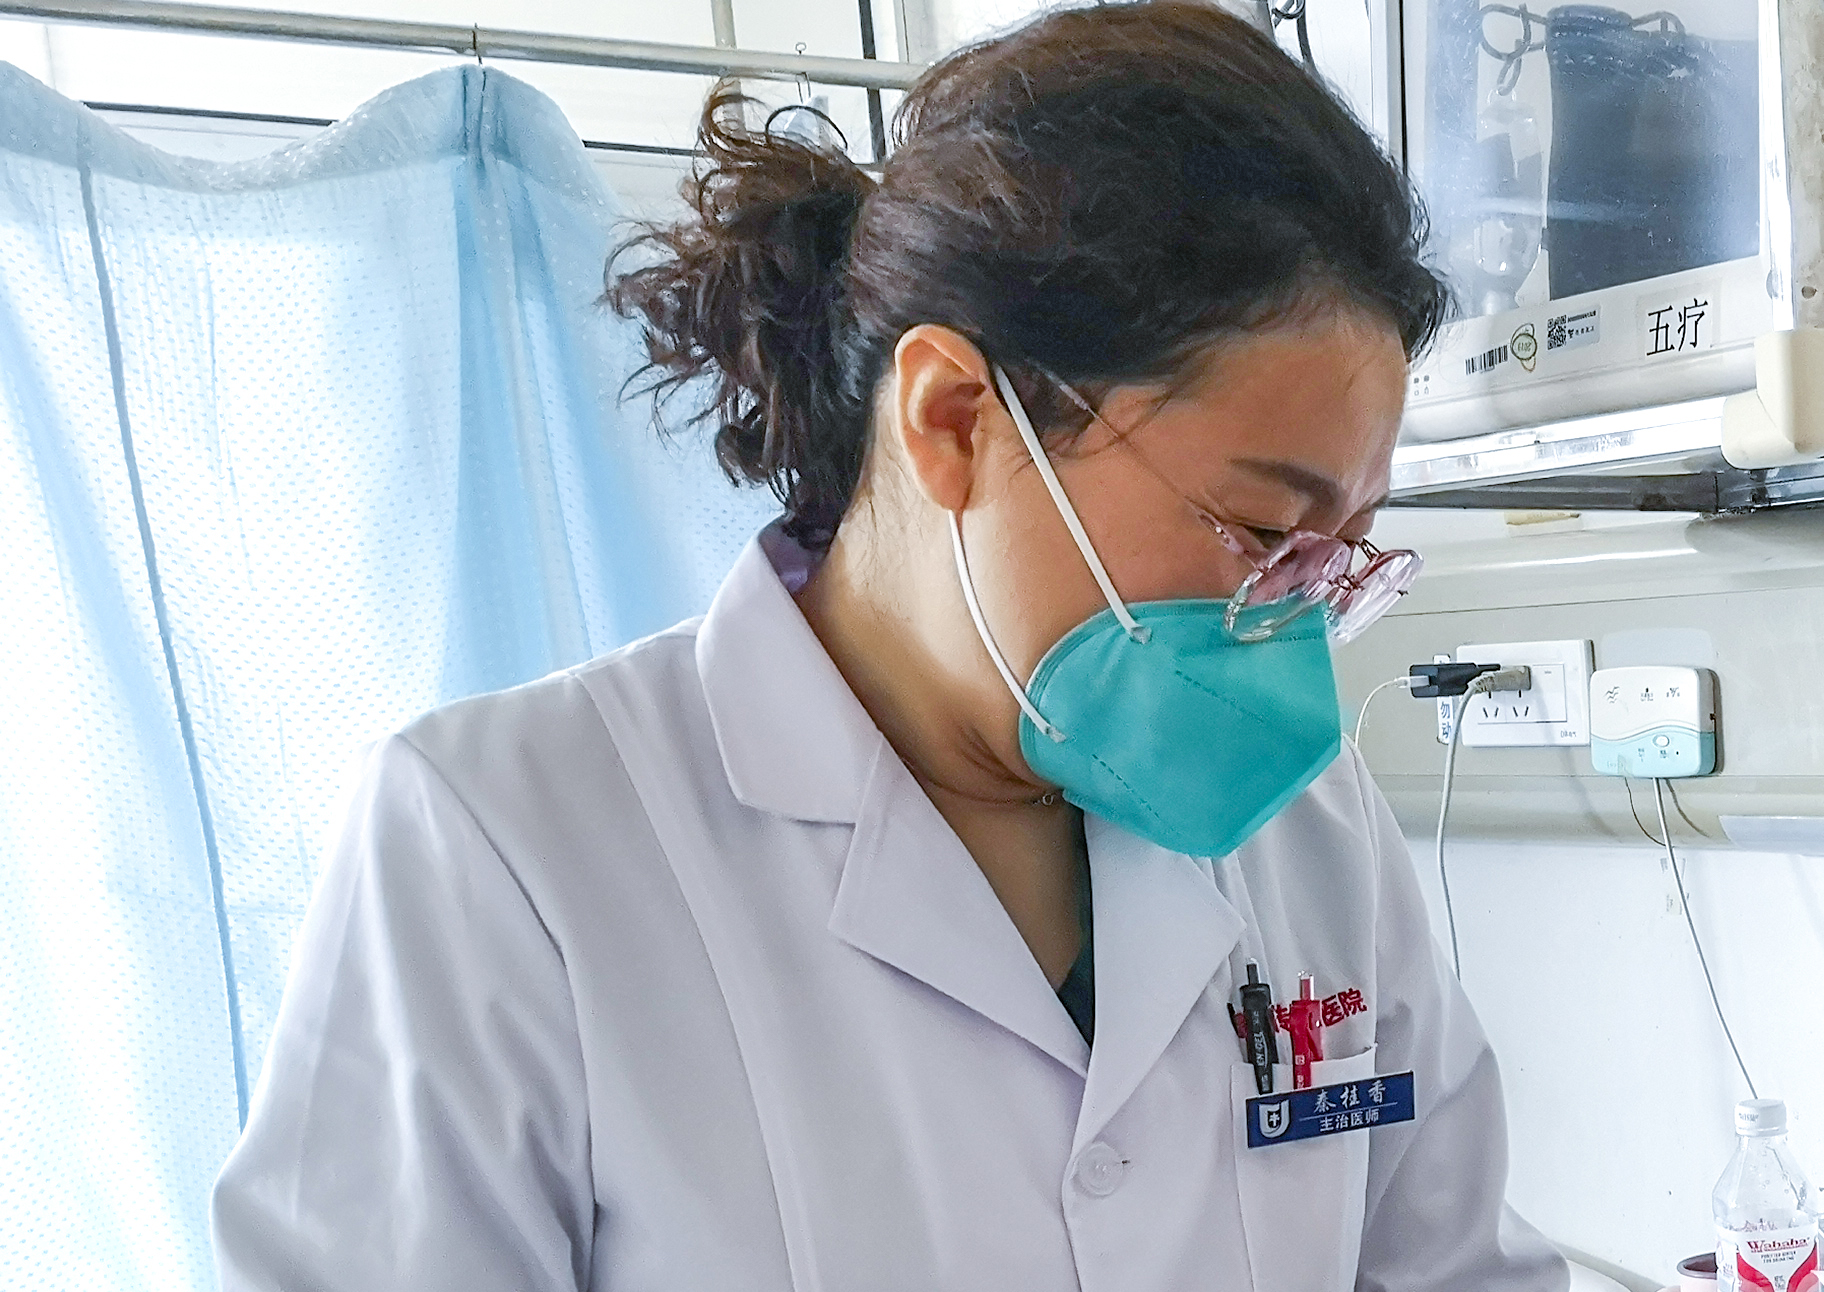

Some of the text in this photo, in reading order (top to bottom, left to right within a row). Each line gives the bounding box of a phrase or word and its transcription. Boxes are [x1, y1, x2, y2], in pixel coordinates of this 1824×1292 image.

[1646, 298, 1708, 356] 五疗
[1319, 1108, 1380, 1133] 主治医师
